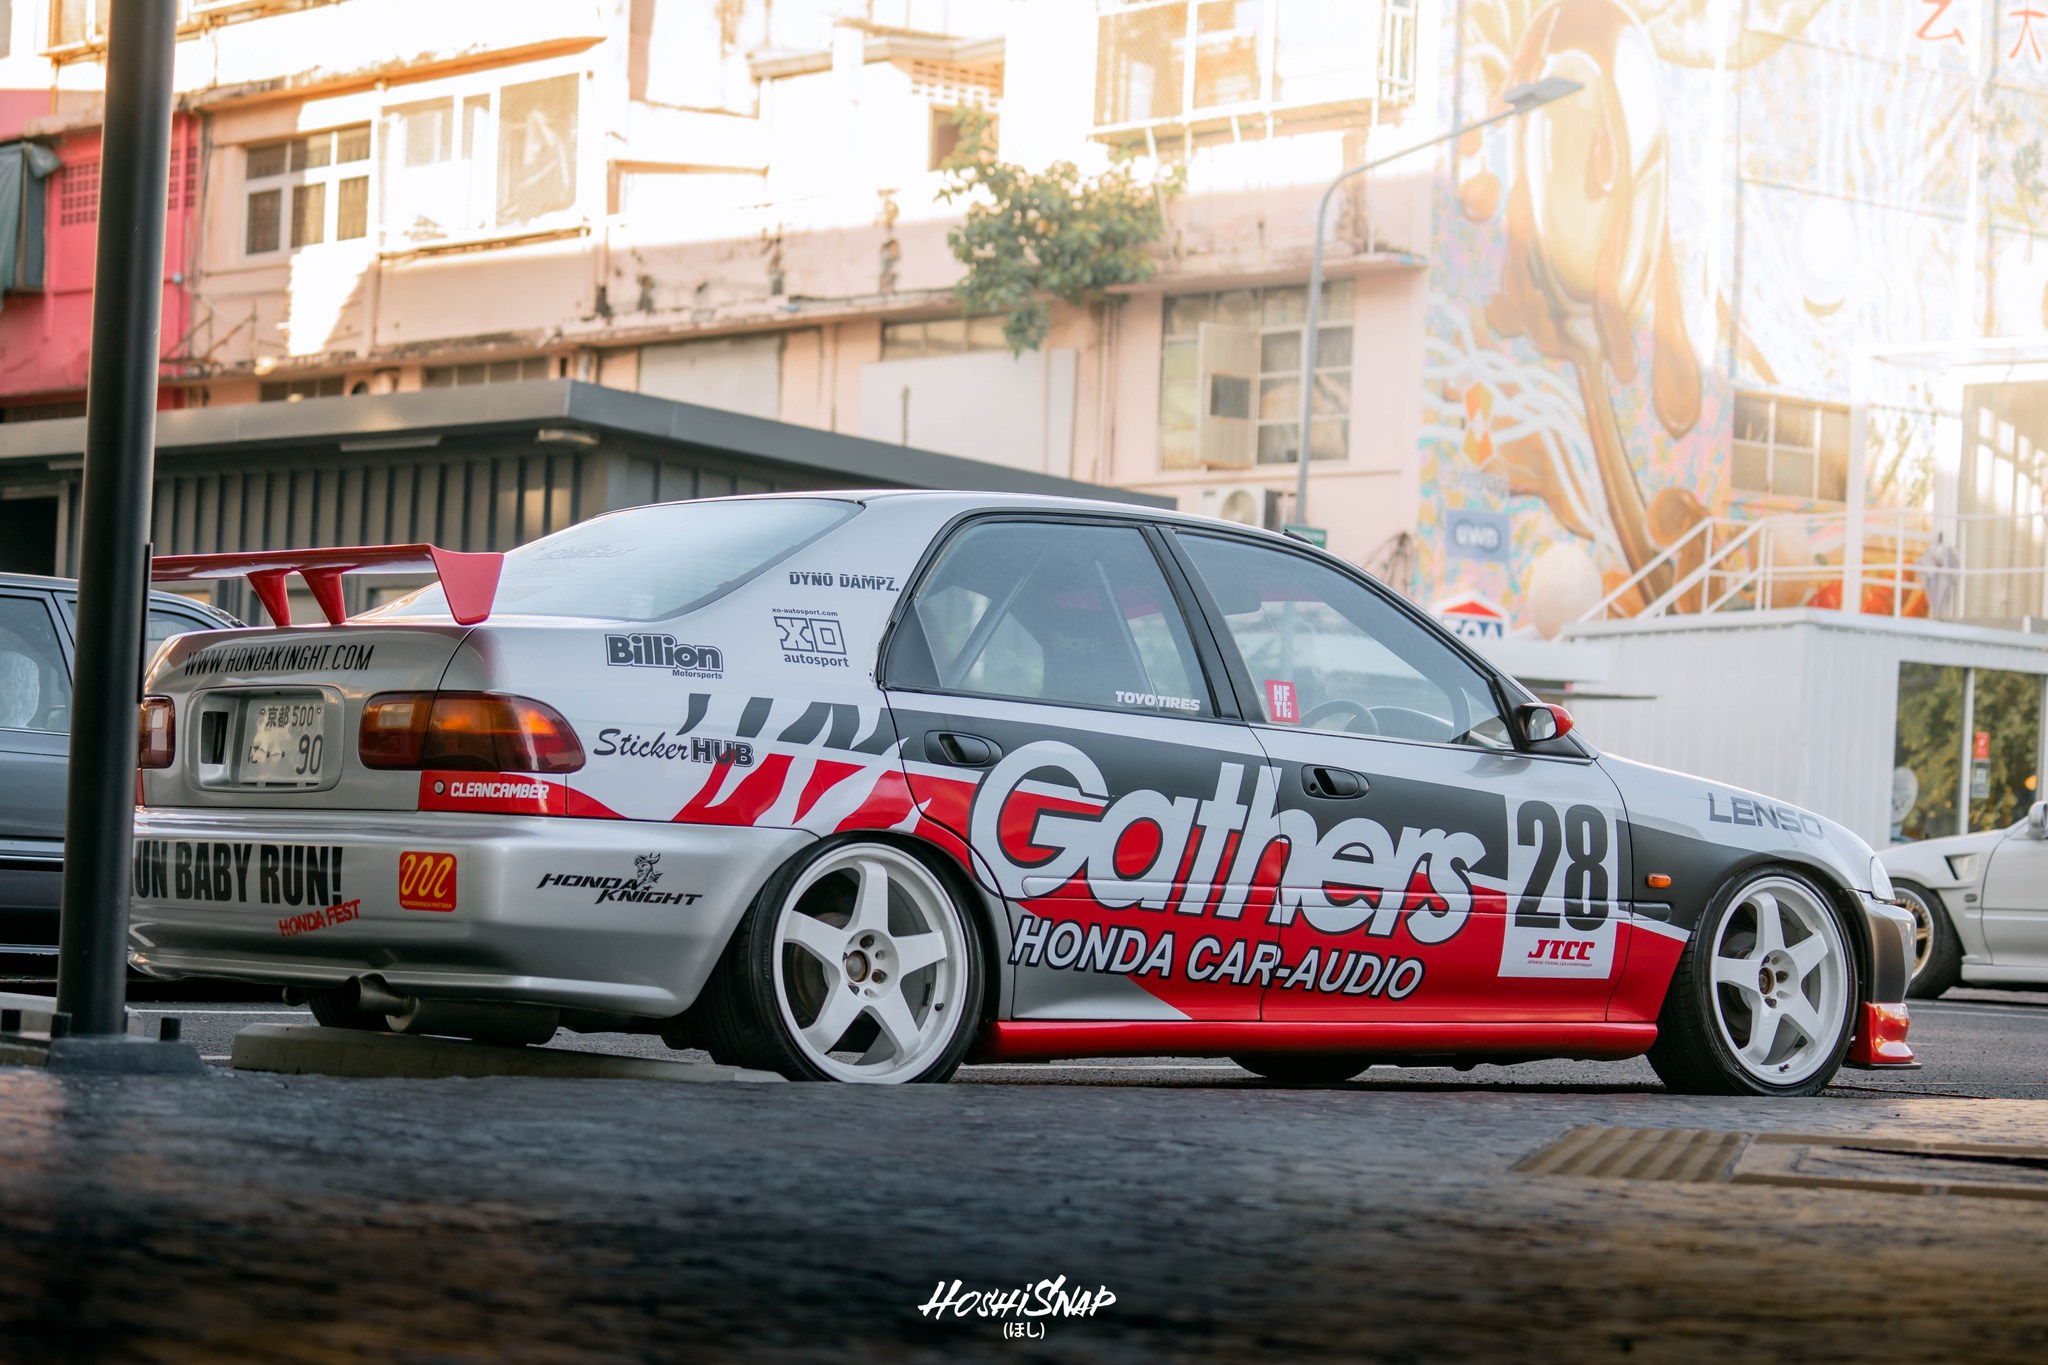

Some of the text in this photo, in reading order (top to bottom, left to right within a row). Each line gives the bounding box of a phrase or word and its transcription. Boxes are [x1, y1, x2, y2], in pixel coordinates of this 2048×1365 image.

[789, 571, 900, 592] DYNO DAMPZ.
[772, 607, 839, 617] xo-autosport.com
[605, 633, 724, 672] Billion
[783, 653, 850, 668] autosport
[672, 669, 723, 680] Motorsports
[291, 705, 315, 727] 500
[295, 733, 324, 775] 90
[593, 728, 755, 768] Sticker HUB
[450, 781, 550, 800] CLEANCAMBER
[1707, 792, 1824, 840] LENSO
[968, 740, 1488, 945] Gathers
[131, 840, 344, 907] UN BABY RUN!
[1514, 800, 1609, 931] 28
[536, 873, 638, 891] HONDA
[594, 889, 703, 906] KNIGHT
[278, 899, 361, 938] HONDA FEST
[1008, 915, 1426, 1001] HONDA CAR-AUDIO
[1527, 939, 1596, 961] JTCC
